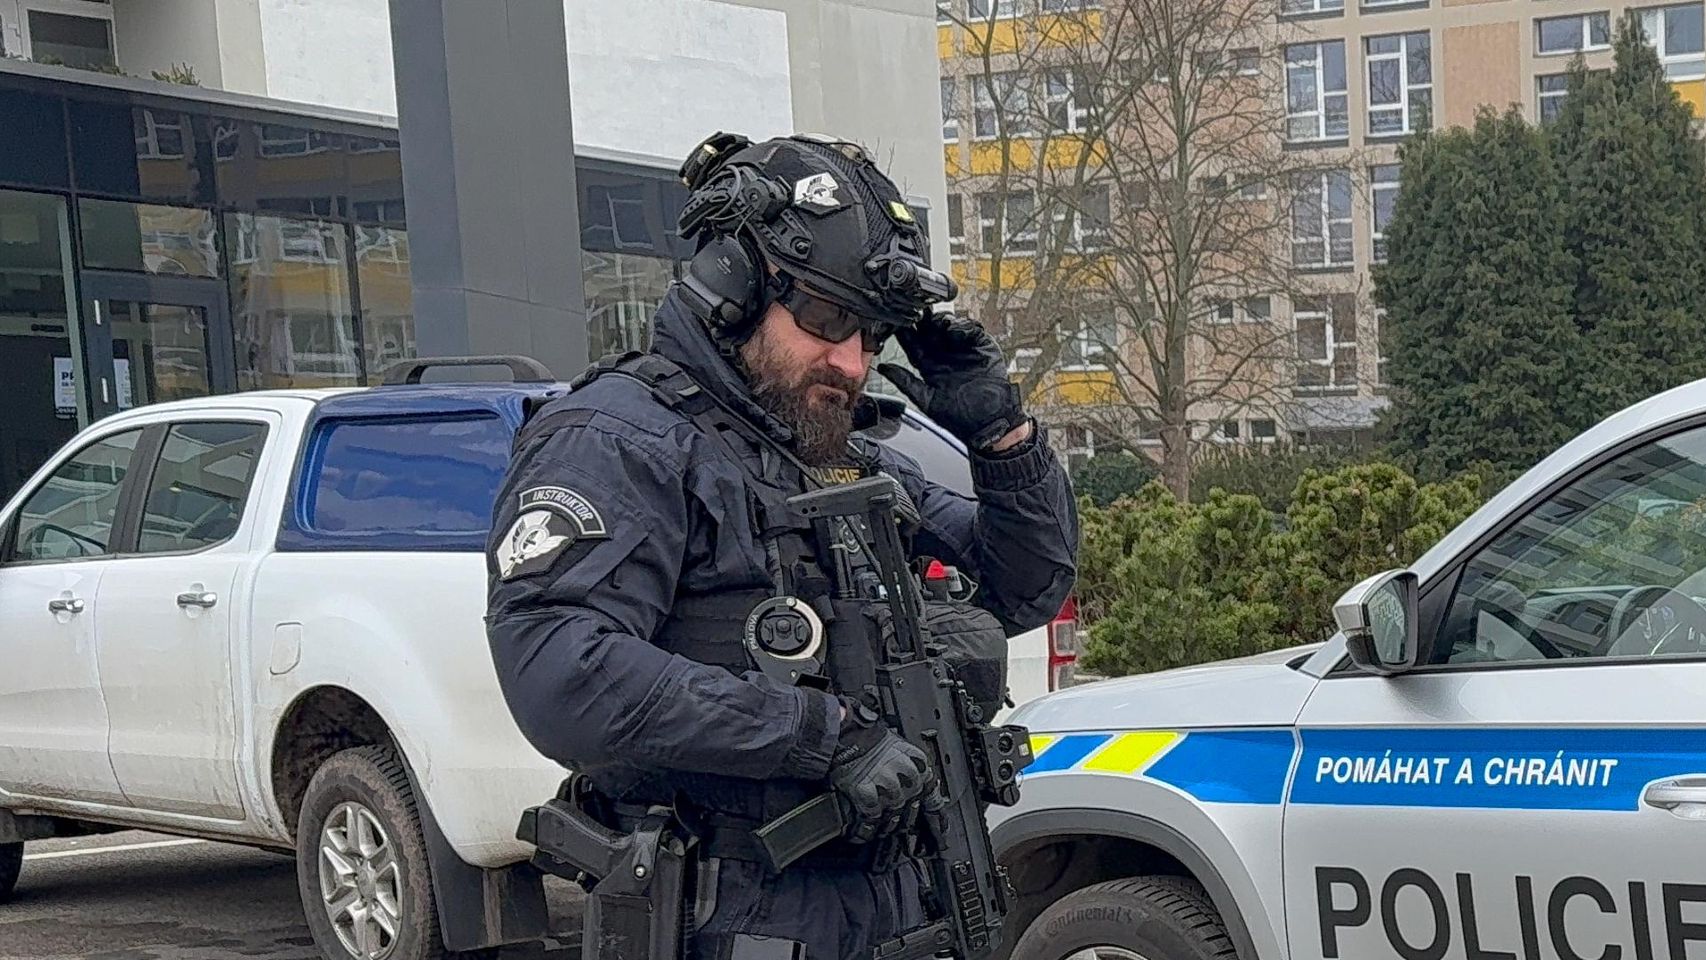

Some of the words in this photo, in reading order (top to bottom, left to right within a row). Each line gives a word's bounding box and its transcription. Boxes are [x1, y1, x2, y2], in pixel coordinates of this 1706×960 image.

[532, 489, 594, 521] INSTRUKTOR
[1315, 749, 1450, 784] POMÁHAT
[1454, 758, 1475, 785] A
[1483, 750, 1619, 787] CHRÁNIT
[1045, 905, 1121, 938] Continental
